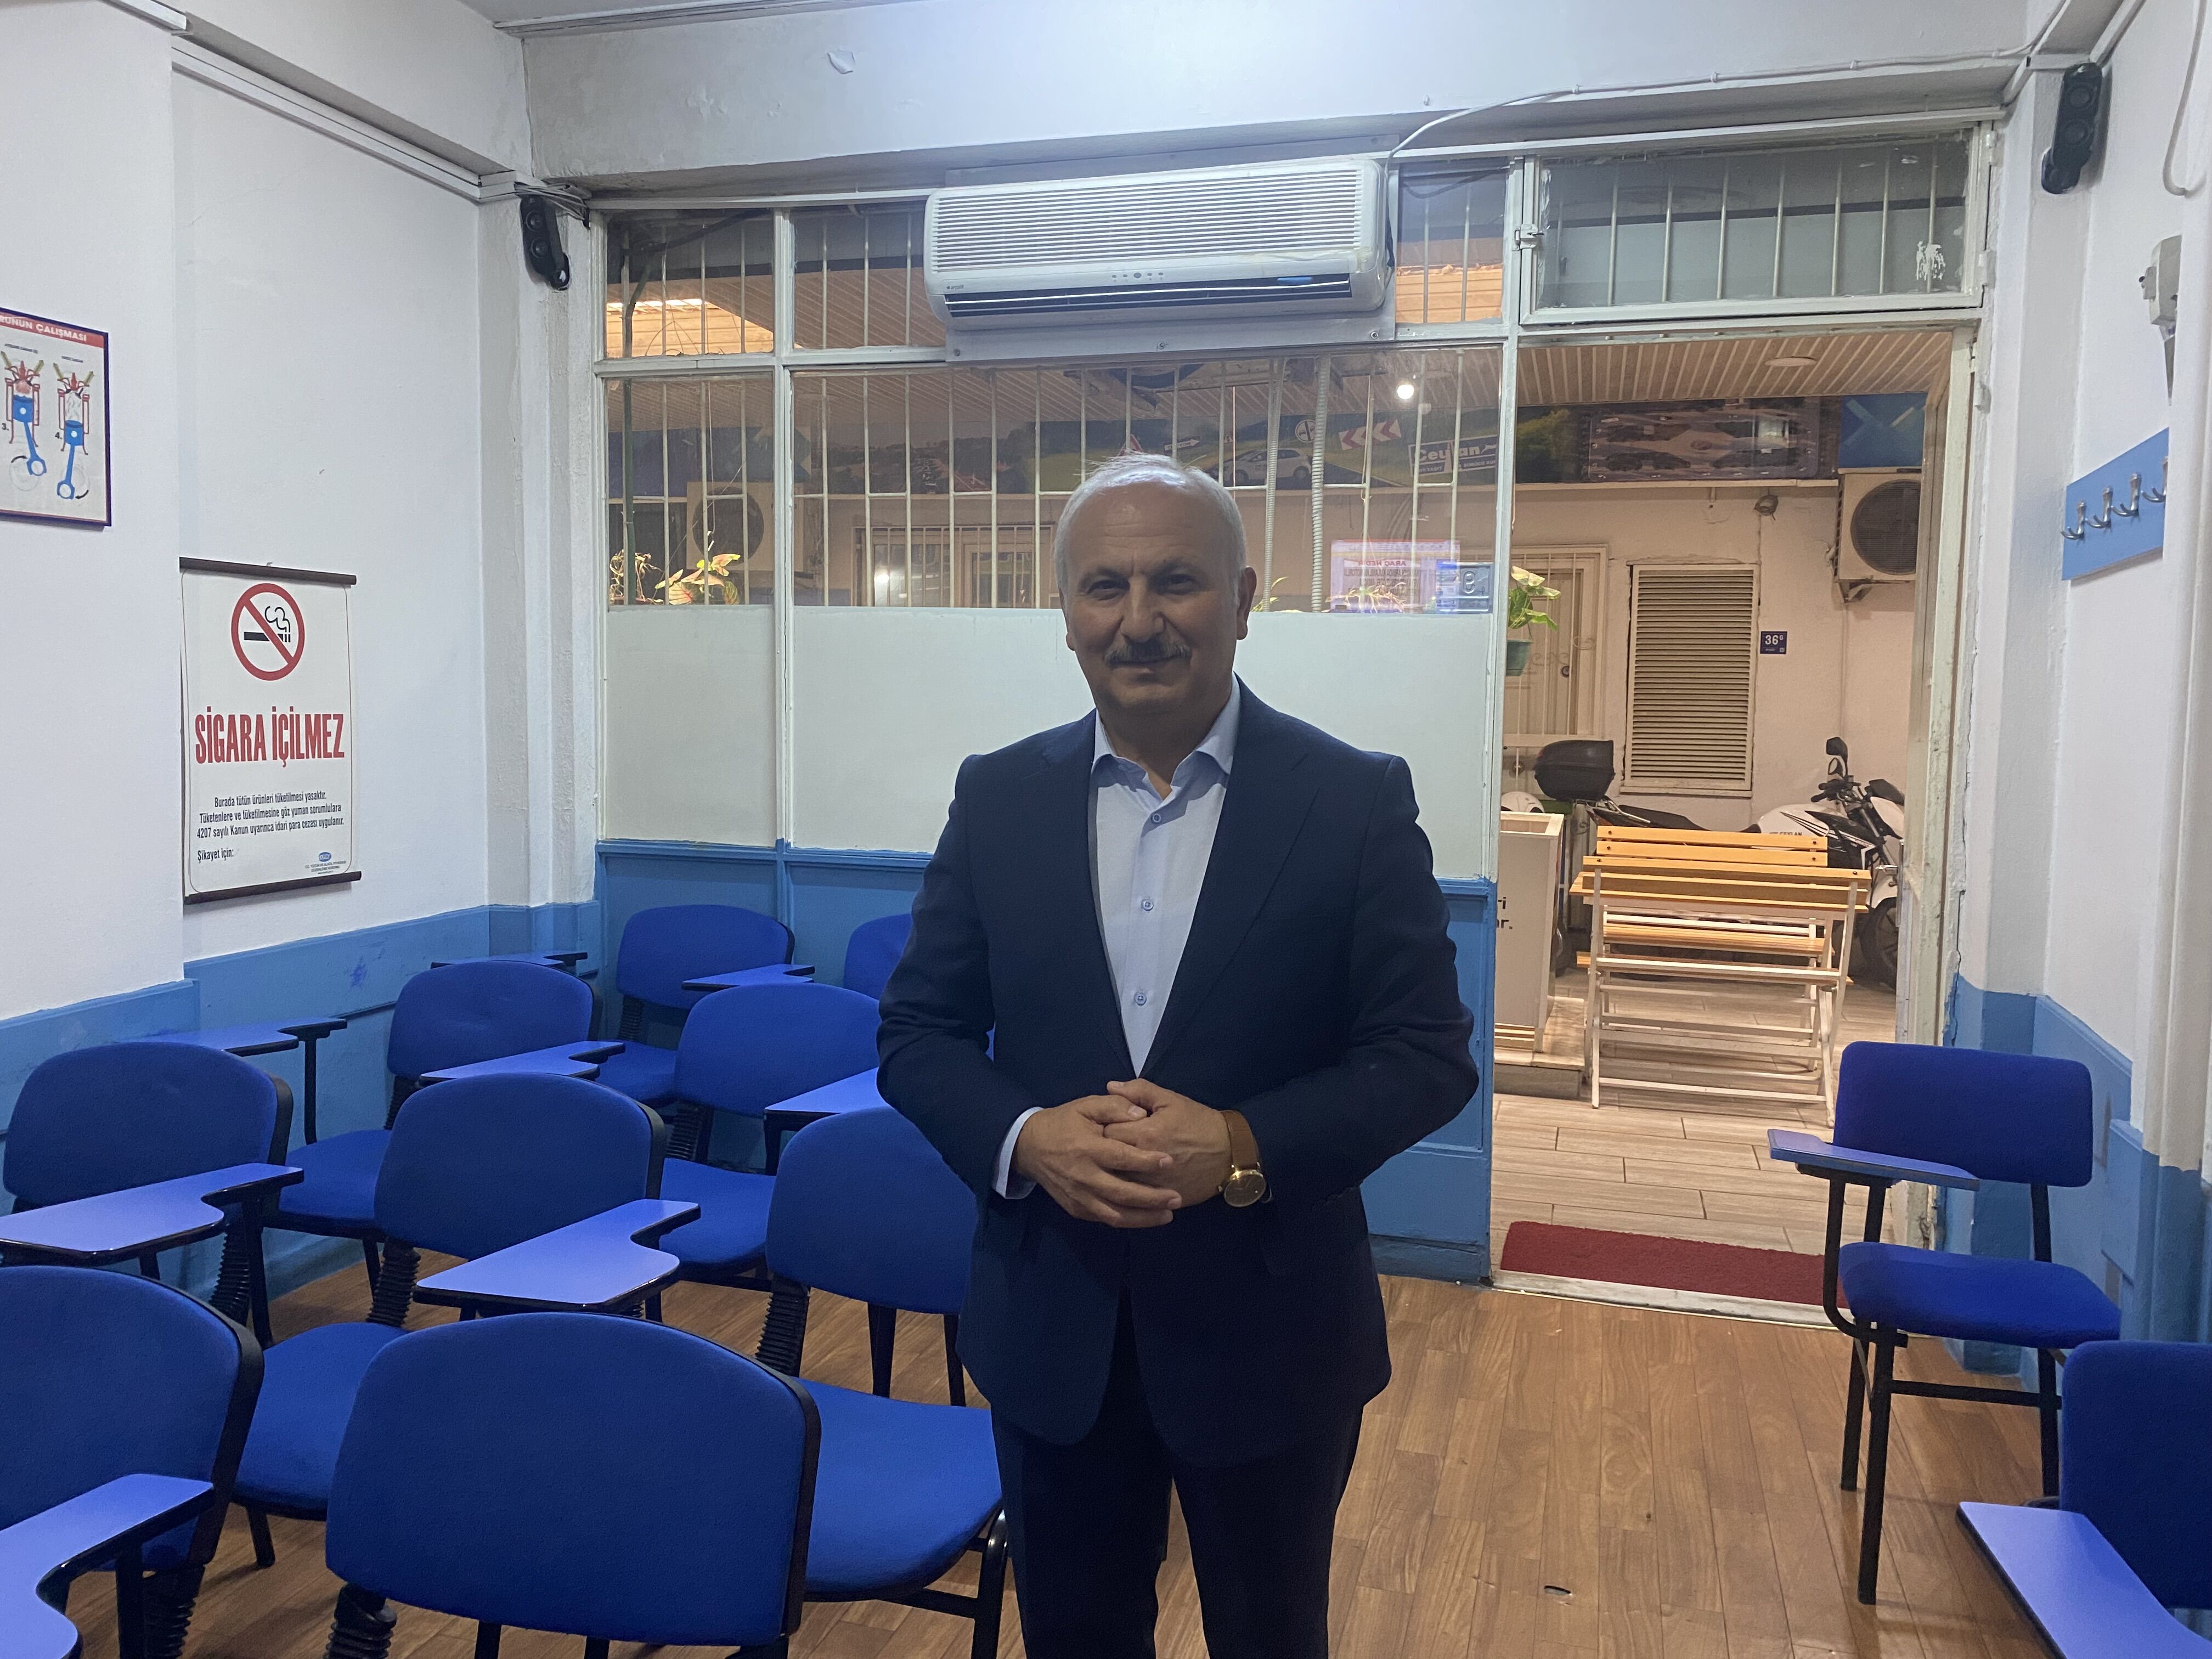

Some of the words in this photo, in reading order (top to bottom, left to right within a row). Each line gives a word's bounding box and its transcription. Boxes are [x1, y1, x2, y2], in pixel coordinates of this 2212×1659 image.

[36, 324, 87, 341] ÇALIŞMASI
[2, 422, 9, 431] 3.
[195, 706, 267, 764] SİGARA
[272, 706, 345, 768] İÇİLMEZ
[215, 796, 235, 807] Burada
[236, 795, 251, 806] tütün
[252, 793, 273, 805] ürünleri
[275, 792, 303, 803] tüketilmesi
[305, 790, 326, 803] yasaktır.
[200, 811, 233, 823] Tüketenlere
[234, 812, 241, 820] ve
[242, 808, 279, 820] tüketilmesine
[281, 806, 290, 819] göz
[291, 806, 308, 817] yuman
[310, 803, 341, 814] sorumlulara
[197, 827, 211, 838] 4207
[213, 826, 229, 838] sayılı
[230, 825, 249, 835] Kanun
[250, 824, 274, 836] uyarınca
[275, 821, 287, 831] idari
[289, 821, 301, 832] para
[302, 820, 317, 828] cezası
[319, 816, 344, 828] uygulanır.
[198, 849, 220, 864] Şikayet
[221, 847, 234, 861] için:
